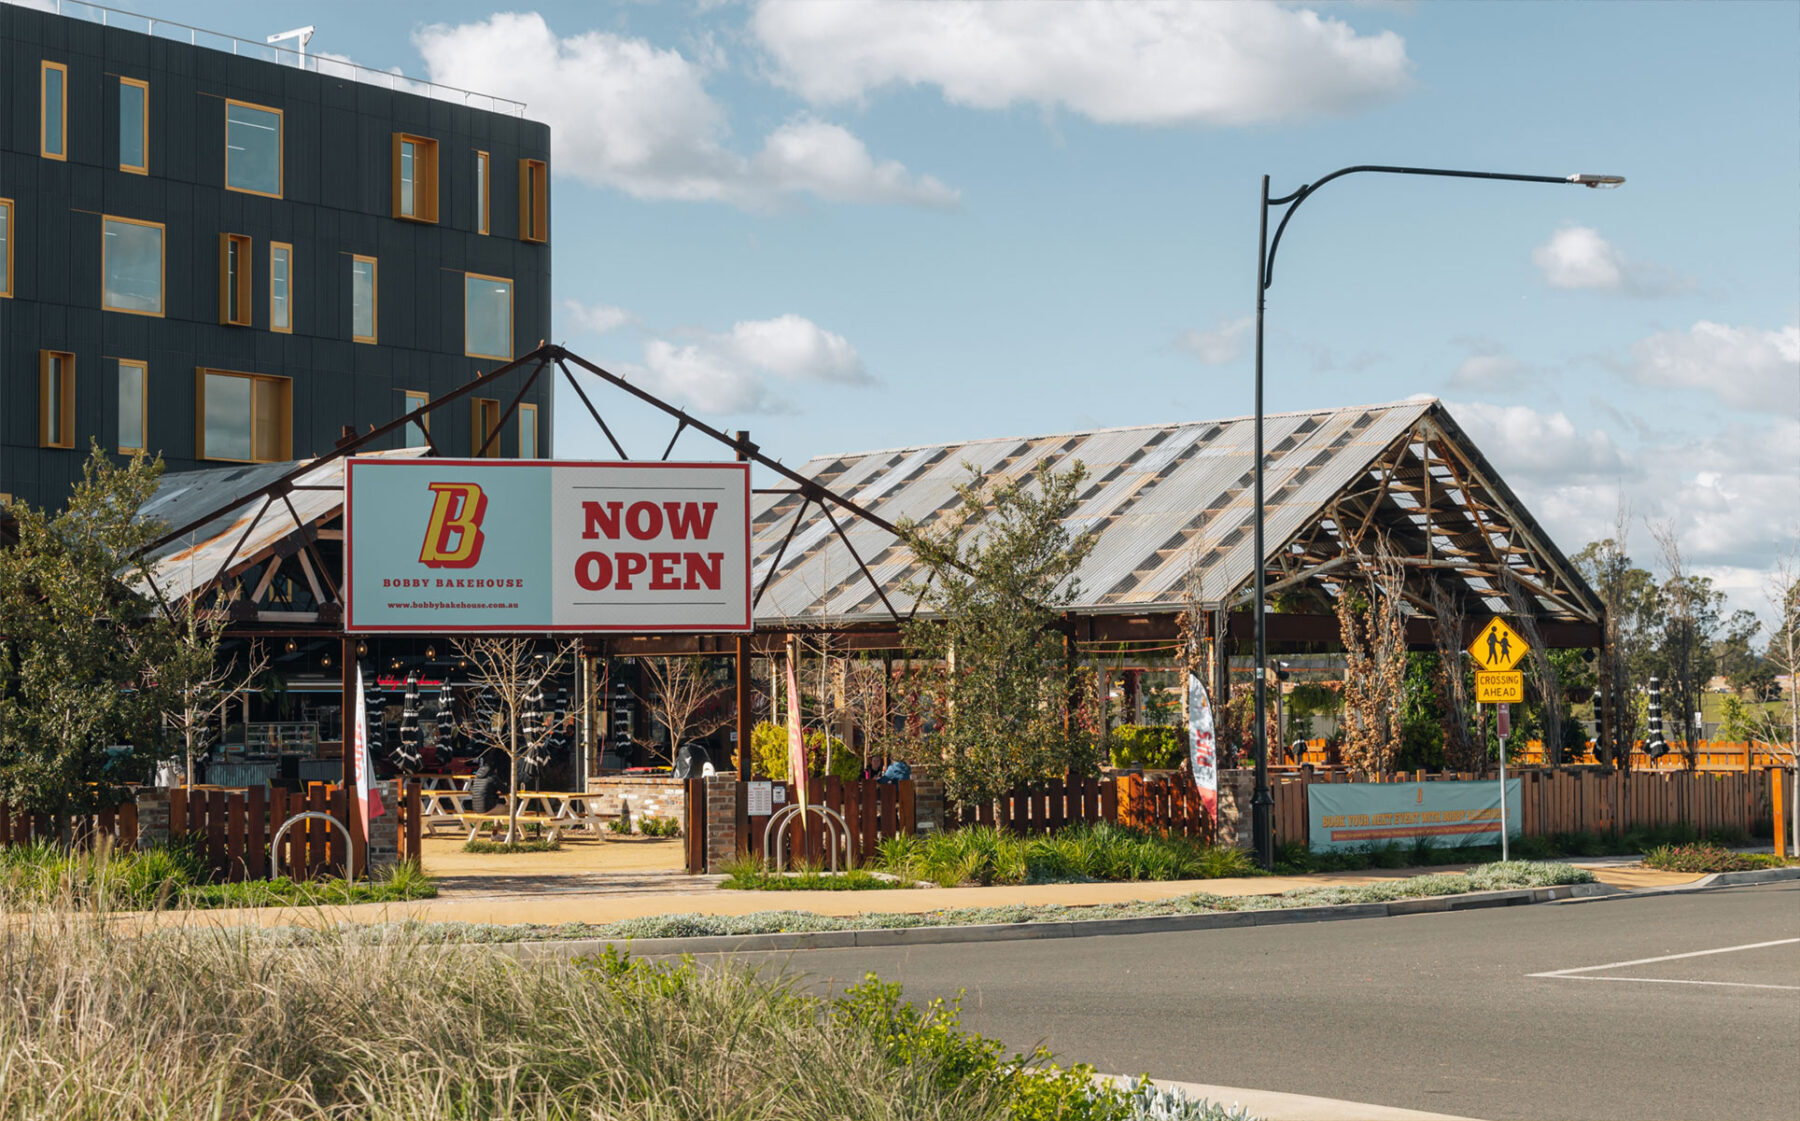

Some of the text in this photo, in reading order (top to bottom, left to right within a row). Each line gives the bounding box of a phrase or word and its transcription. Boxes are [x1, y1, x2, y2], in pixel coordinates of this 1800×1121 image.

[418, 482, 488, 569] B
[582, 501, 718, 540] NOW
[574, 551, 724, 591] OPEN
[383, 578, 524, 588] BOBBY BAKEHOUSE
[387, 601, 519, 610] www.bobbybakehouse.com.au
[1480, 676, 1519, 685] CROSSING
[1483, 688, 1516, 696] AHEAD
[1322, 814, 1346, 829] BOOK
[1347, 813, 1370, 828] YOUR
[1371, 812, 1393, 827] NEXT
[1394, 811, 1420, 825] EVENT
